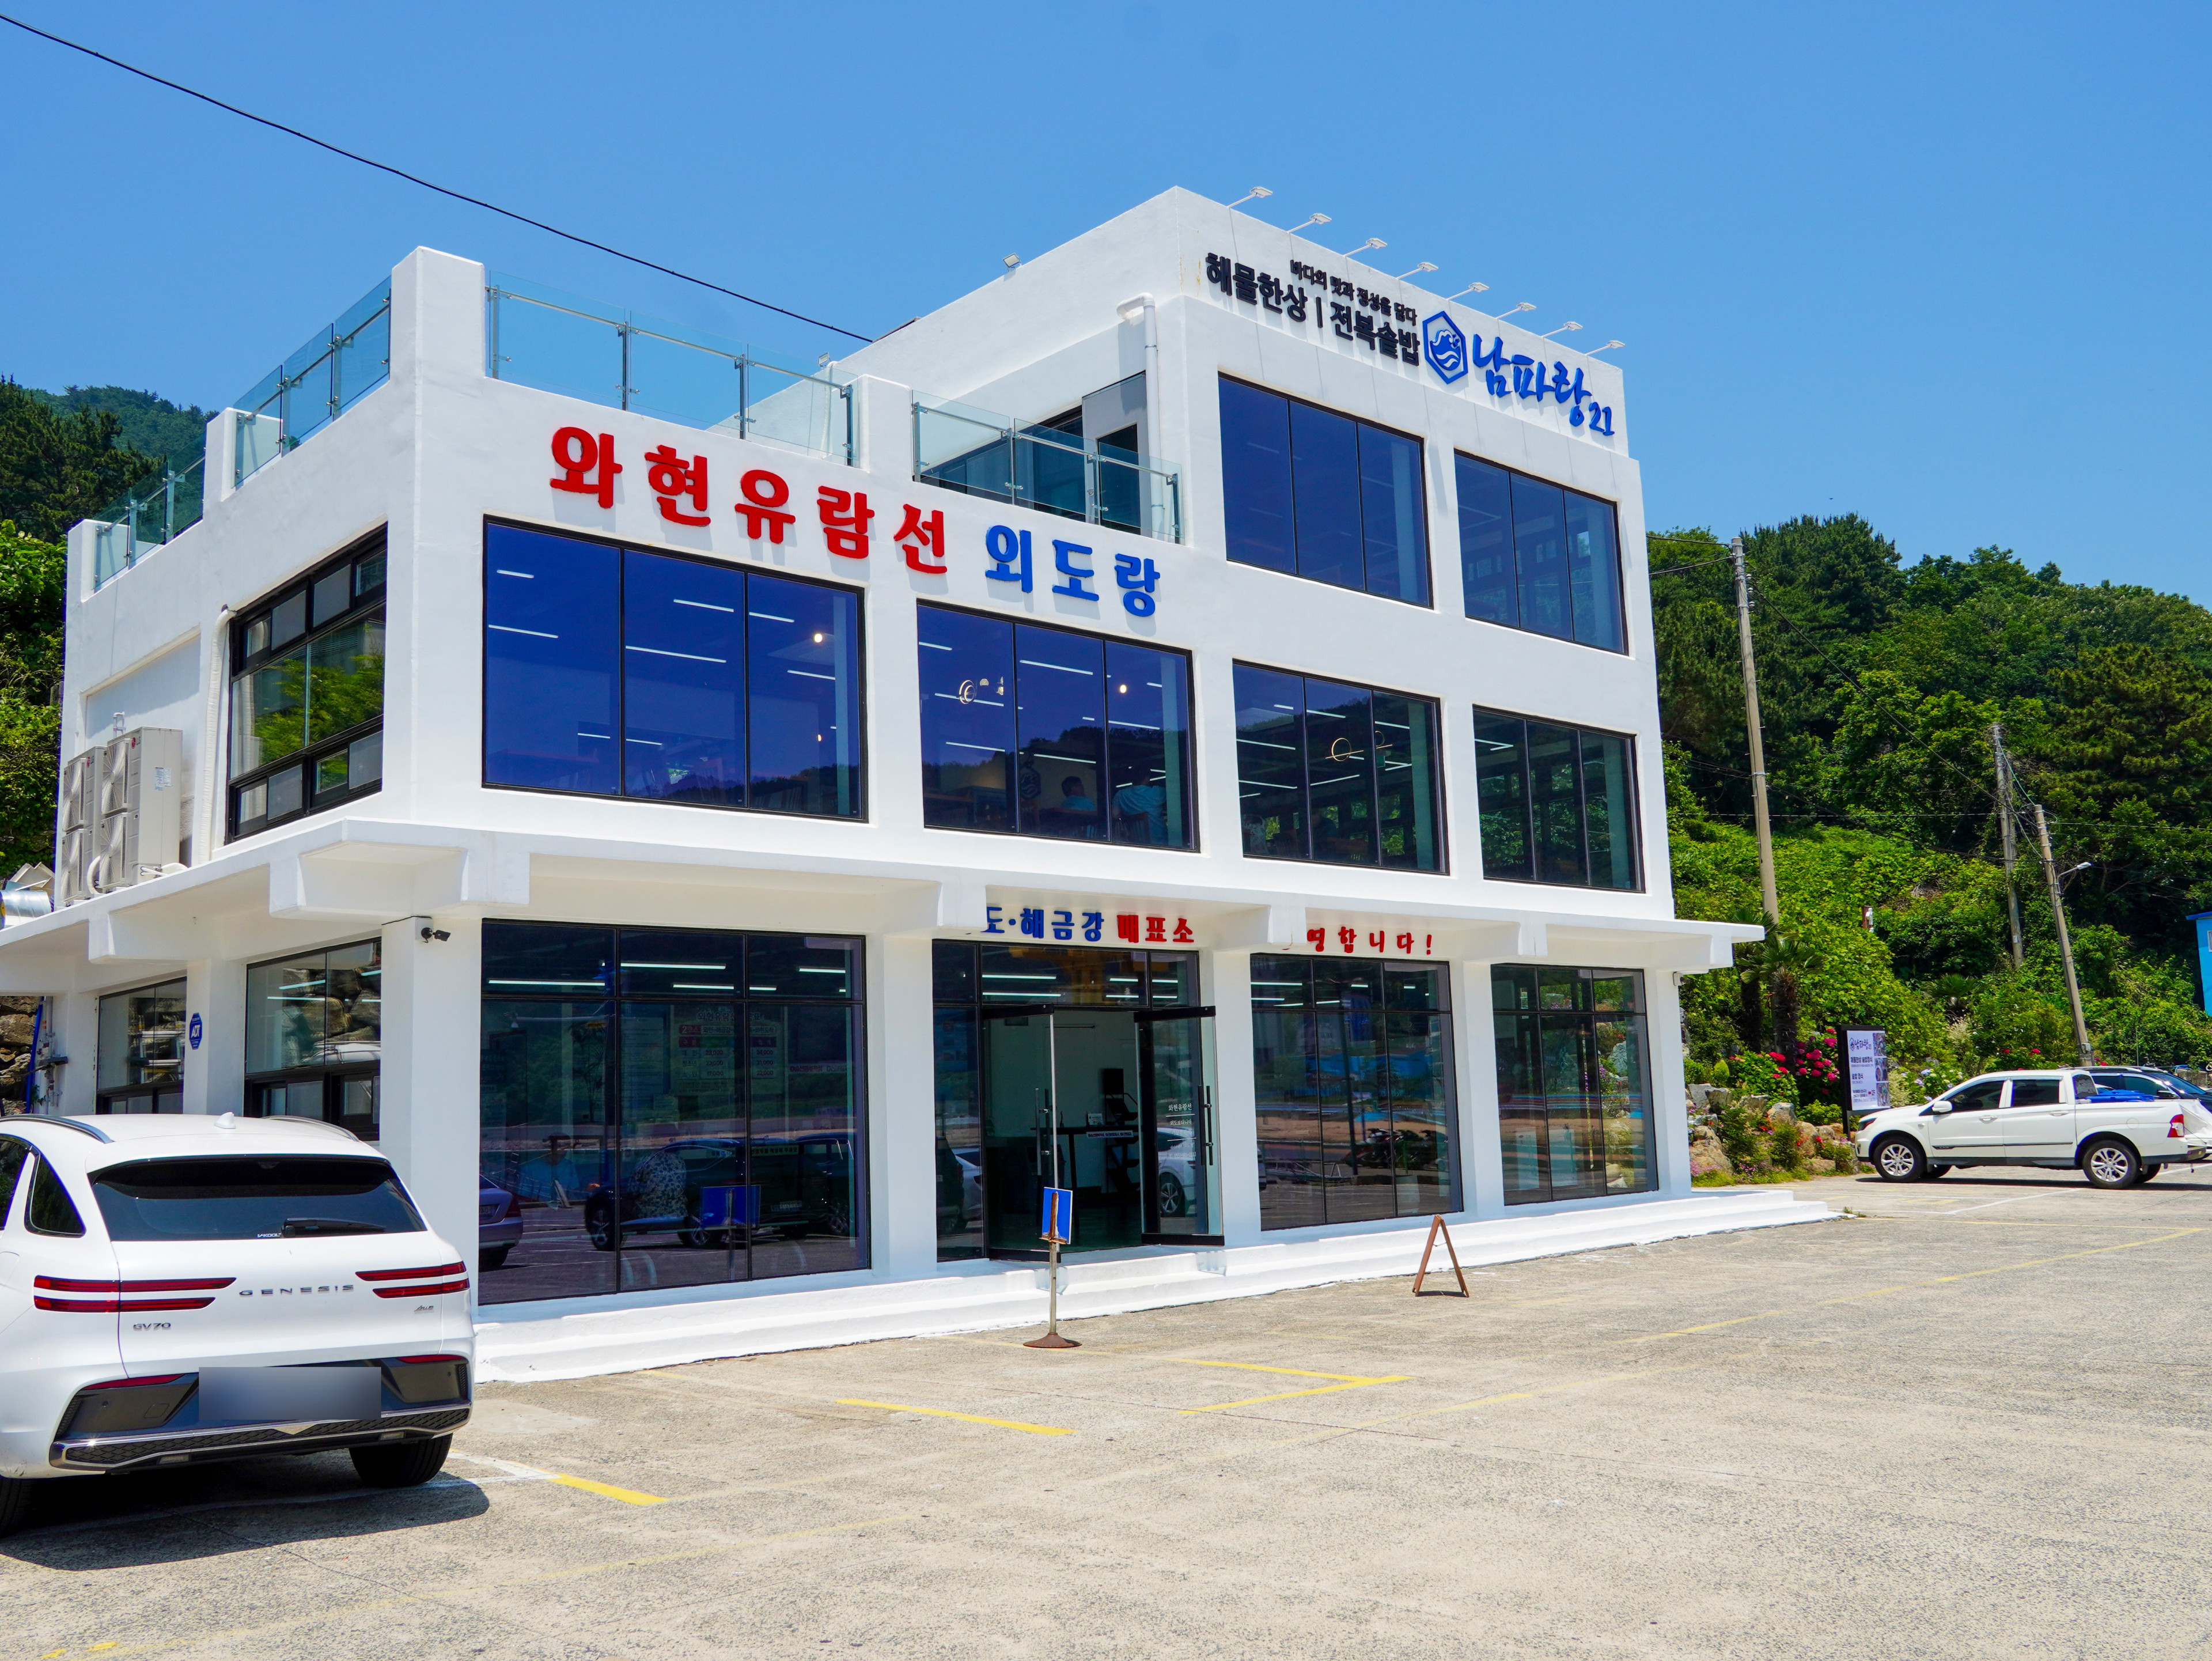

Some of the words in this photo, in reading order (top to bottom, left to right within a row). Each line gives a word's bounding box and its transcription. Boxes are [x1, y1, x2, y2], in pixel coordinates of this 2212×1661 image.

[1290, 259, 1327, 290] 바다의
[1357, 287, 1392, 317] 정성을
[1394, 302, 1418, 326] 담다
[1205, 252, 1308, 323] 해물한상
[1330, 301, 1421, 366] 전복솥밥
[549, 426, 948, 574] 와현유람선
[985, 525, 1161, 618] 외도랑
[136, 736, 141, 746] LG
[90, 755, 94, 765] LG
[965, 906, 1104, 942] 도·해금강
[1116, 914, 1194, 943] 매표소
[1282, 926, 1432, 955] 영합니다!
[191, 1024, 200, 1038] ADT
[1168, 1103, 1192, 1112] 와현유람선
[239, 1284, 354, 1296] GENESIS
[133, 1322, 172, 1331] GV70
